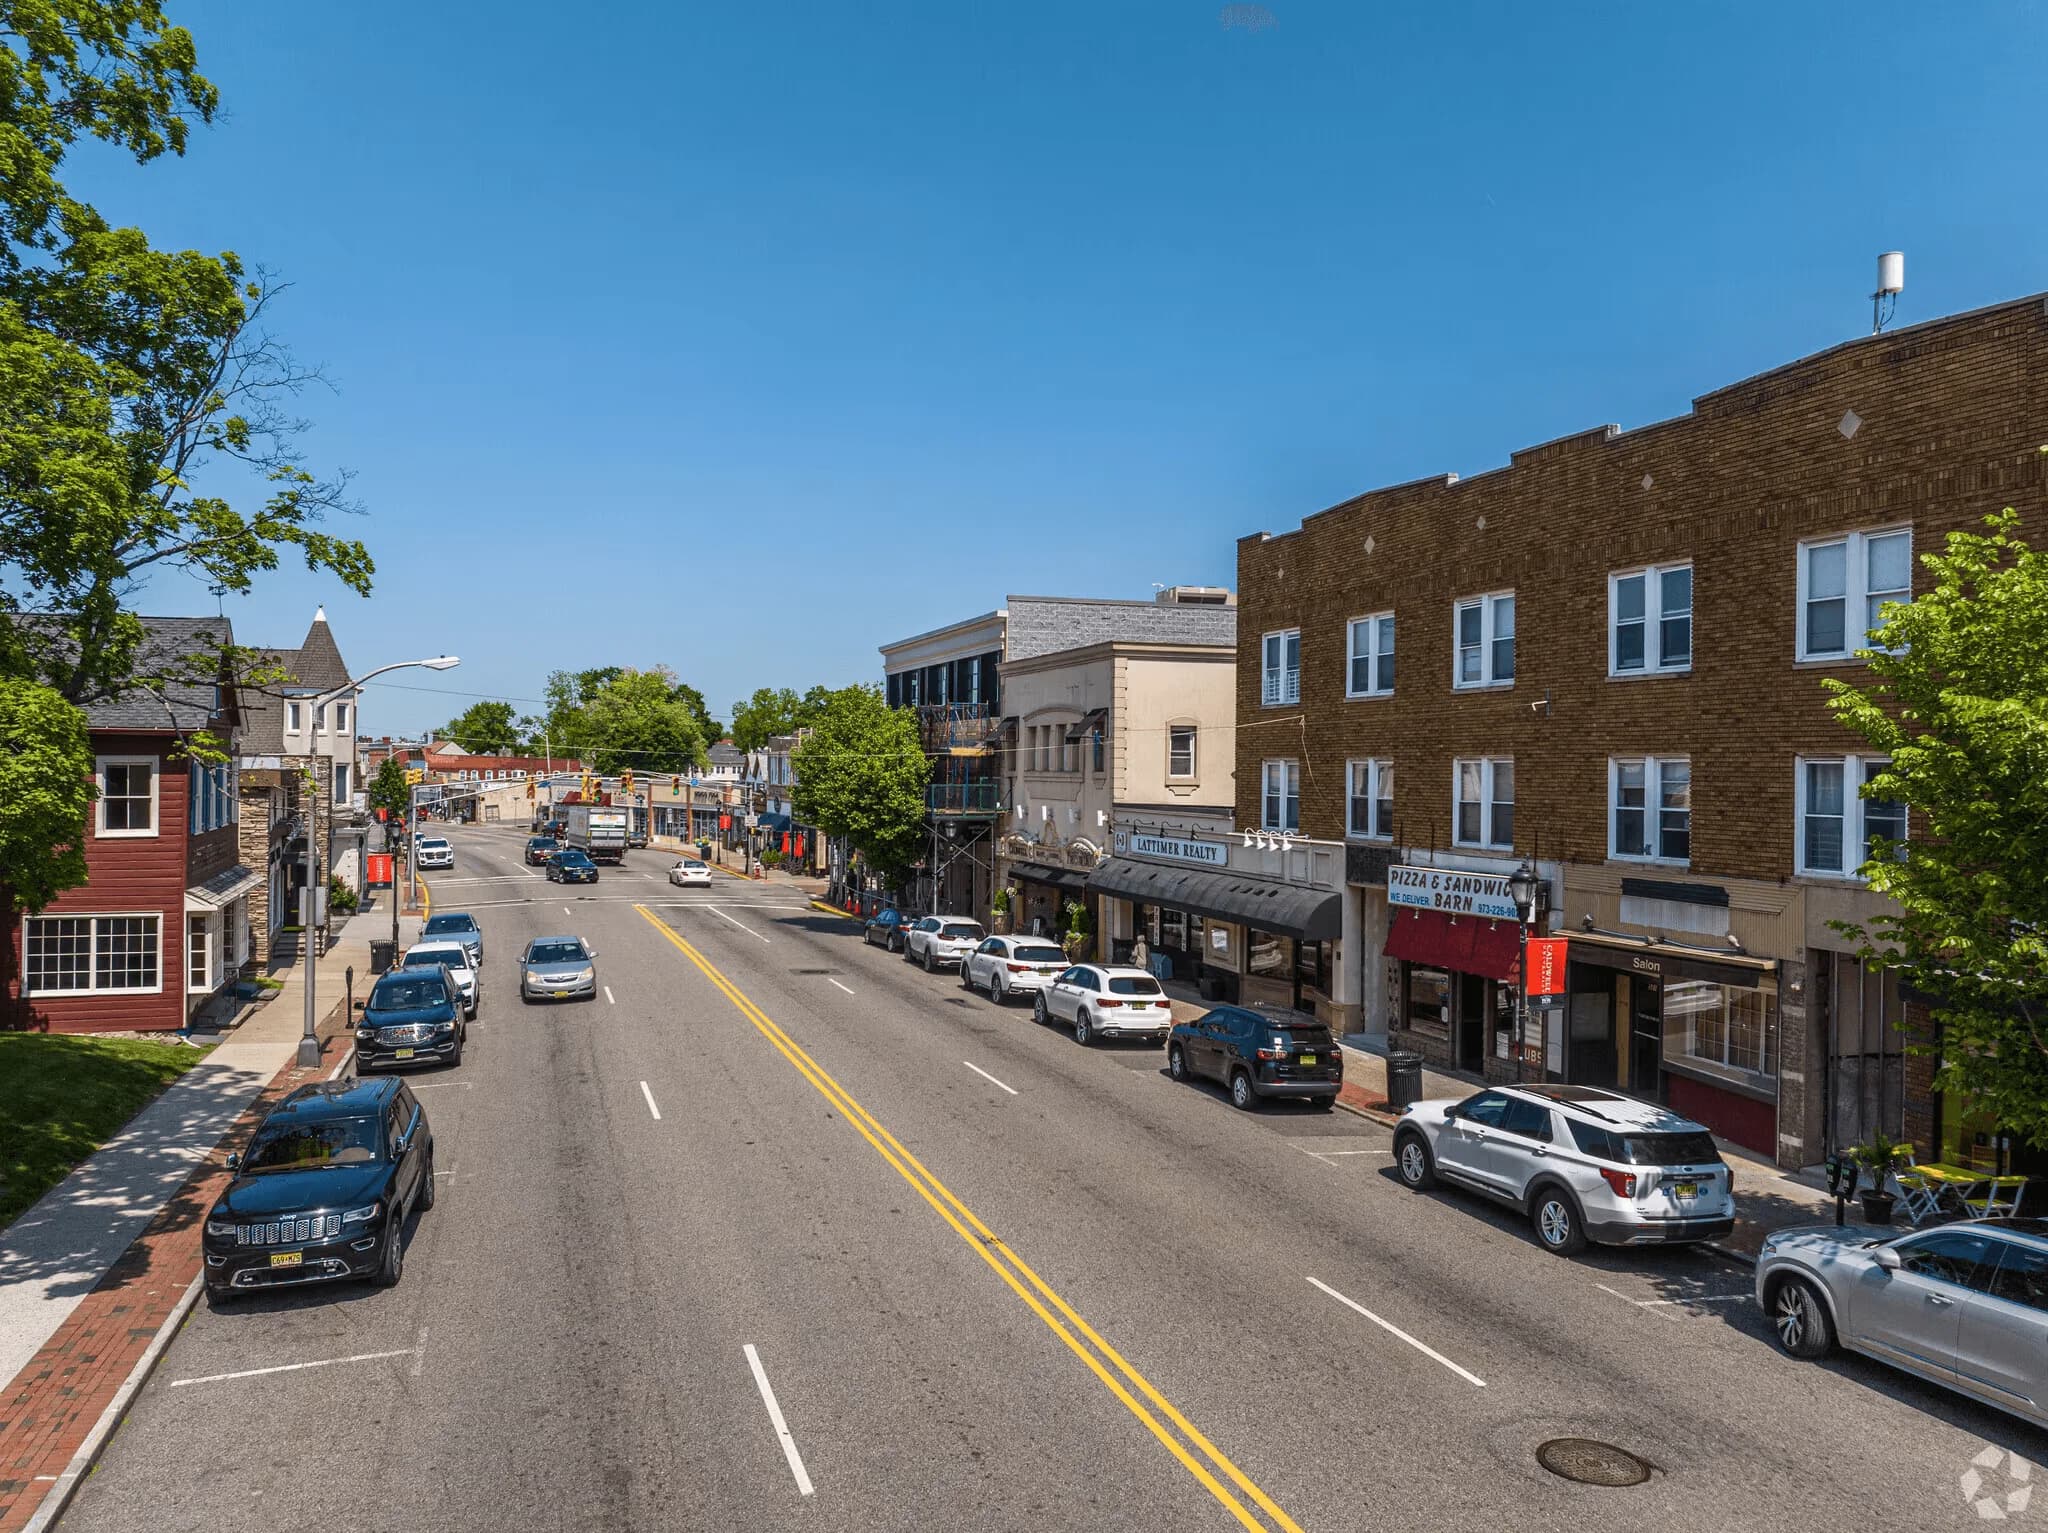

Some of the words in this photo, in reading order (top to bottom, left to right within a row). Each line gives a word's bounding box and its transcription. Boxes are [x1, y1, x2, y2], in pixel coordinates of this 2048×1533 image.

[1137, 838, 1179, 856] LATTIMER
[1183, 844, 1217, 860] REALTY
[1391, 870, 1427, 888] PIZZA
[1431, 875, 1439, 889] &
[1444, 876, 1513, 898] SANDWIC
[1390, 893, 1401, 901] WE
[1402, 894, 1430, 906] DELIVER
[1434, 893, 1473, 912] BARN
[1478, 903, 1519, 918] 973-226-90
[1544, 944, 1553, 993] CALDWELL
[1633, 957, 1660, 971] Salon
[1523, 1047, 1542, 1064] UBS
